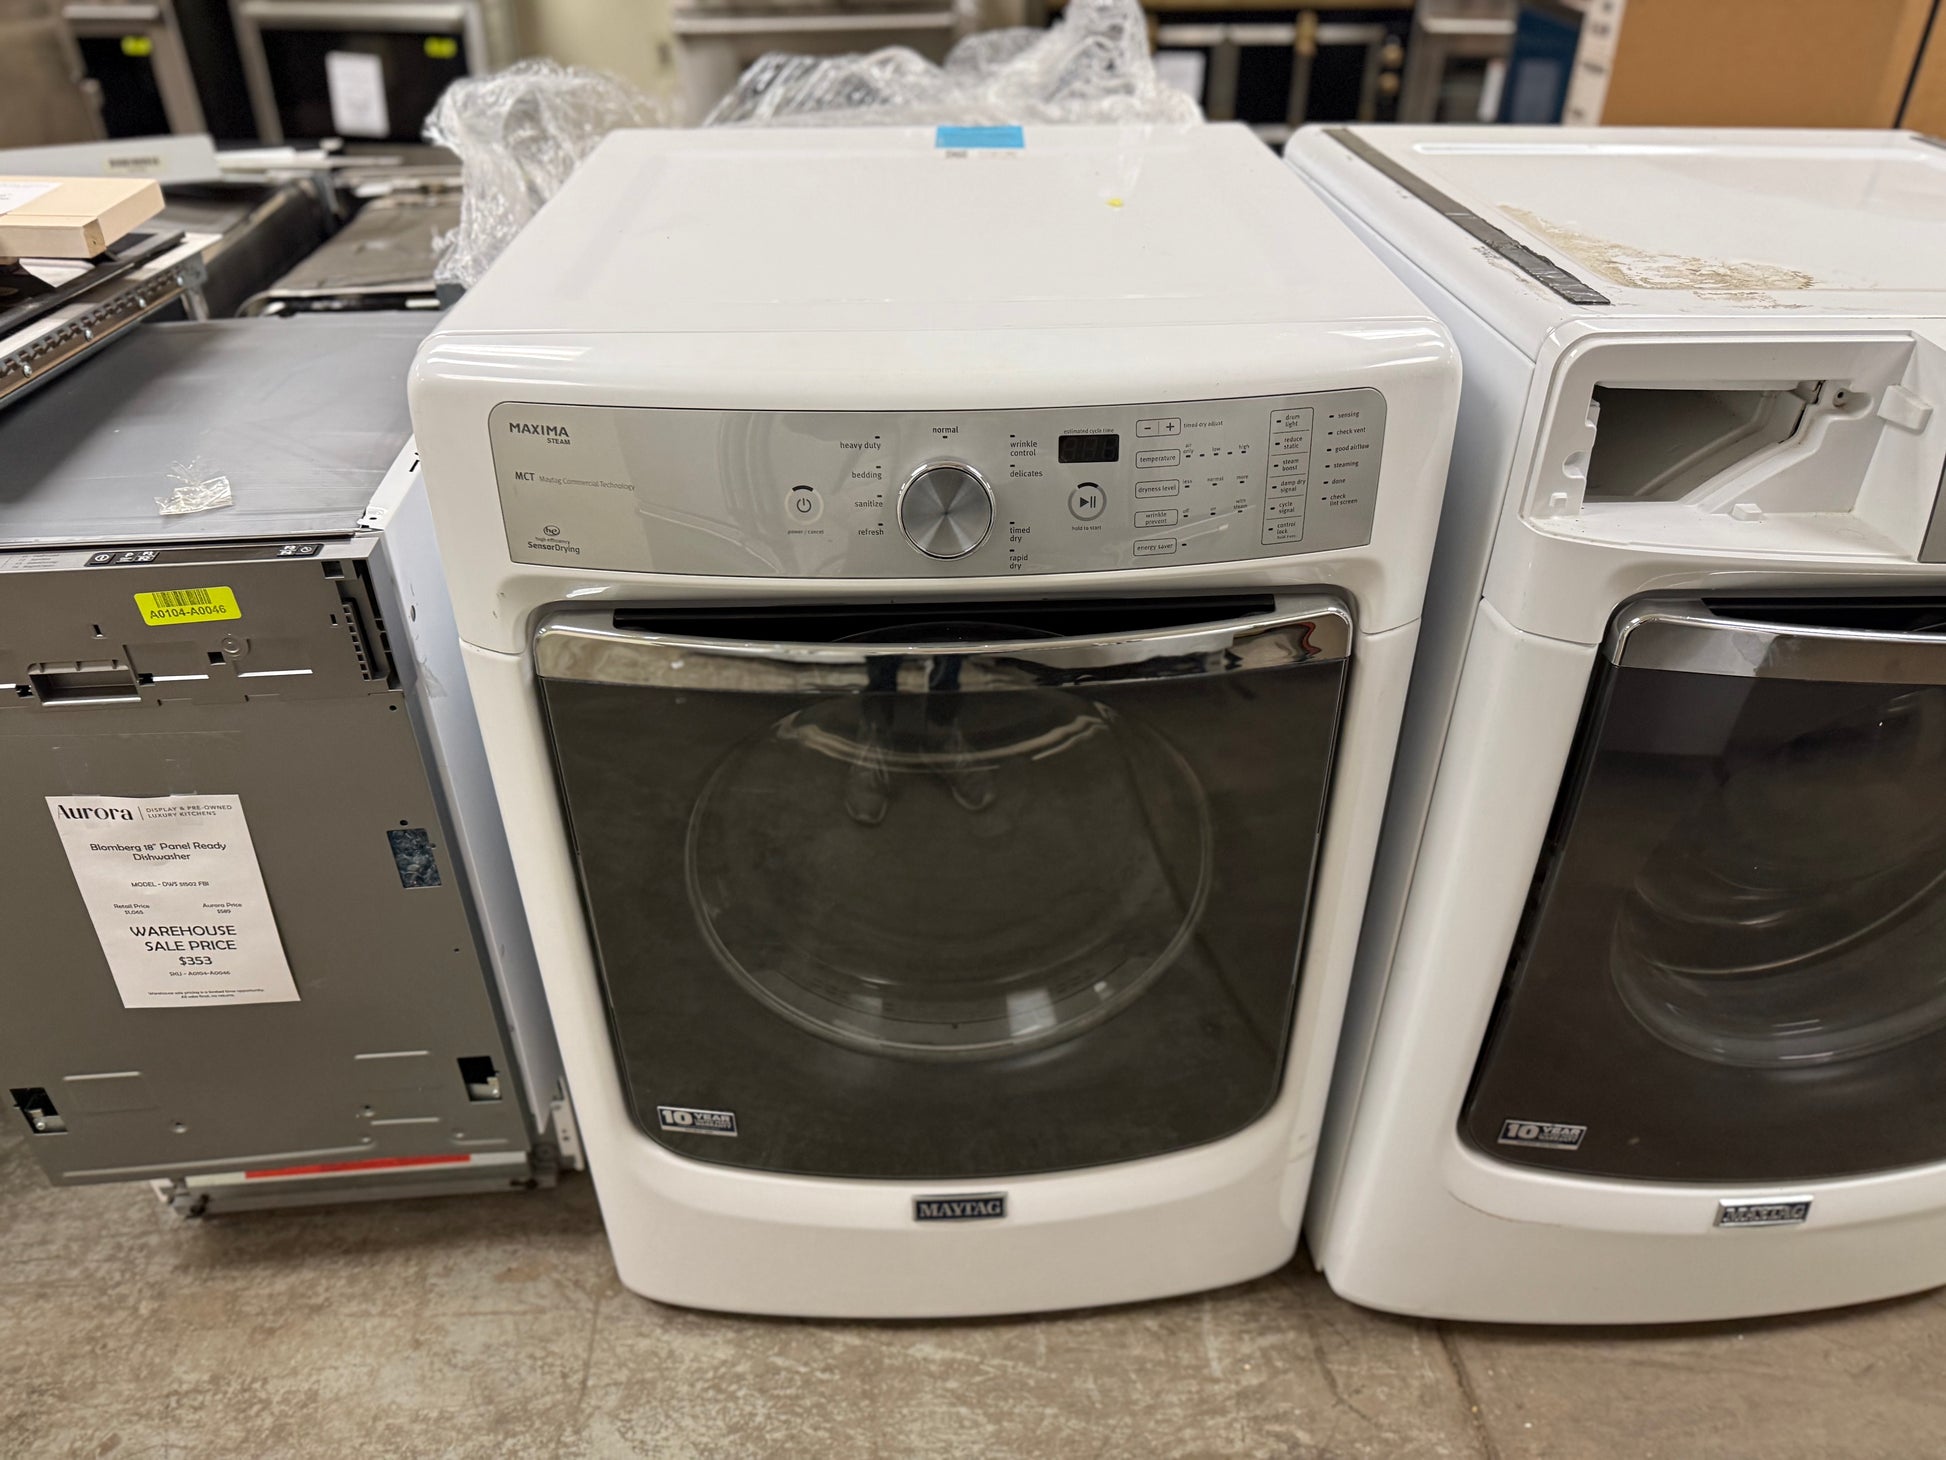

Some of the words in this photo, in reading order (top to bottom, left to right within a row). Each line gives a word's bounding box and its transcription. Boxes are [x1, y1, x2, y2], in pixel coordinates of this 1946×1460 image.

[509, 422, 569, 437] MAXIMA
[932, 426, 959, 434] normal
[840, 441, 862, 450] heavy
[864, 441, 881, 450] duty
[1010, 440, 1038, 448] wrinkle
[1010, 449, 1036, 457] control
[1335, 445, 1349, 453] good
[1140, 455, 1176, 463] temperature
[1333, 461, 1359, 469] steaming
[852, 471, 882, 480] bedding
[515, 471, 535, 481] MCT
[539, 476, 562, 485] Maytag
[563, 478, 600, 487] Commercial
[600, 481, 635, 491] Technology
[854, 500, 883, 508] sanitize
[1279, 507, 1295, 515] signal
[1009, 526, 1031, 534] timed
[1009, 535, 1022, 543] dry
[527, 541, 580, 555] SensorDrying
[1009, 554, 1028, 562] rapid
[1009, 562, 1022, 570] dry
[150, 604, 227, 619] A0104-A0046
[57, 804, 134, 821] Aurora
[90, 843, 141, 853] Blomberg
[143, 843, 157, 851] 18"
[159, 842, 191, 850] Panel
[193, 842, 227, 851] Ready
[133, 853, 191, 862] Dishwasher
[129, 925, 237, 937] WAREHOUSE
[144, 941, 185, 951] SALE
[188, 940, 237, 951] PRICE
[178, 956, 213, 966] $353
[661, 1110, 693, 1126] 10
[693, 1113, 731, 1122] YEAR
[1507, 1123, 1540, 1139] 10
[1542, 1126, 1580, 1135] YEAR
[919, 1200, 1000, 1217] MAYTAG
[1723, 1205, 1806, 1222] MAYTAG
